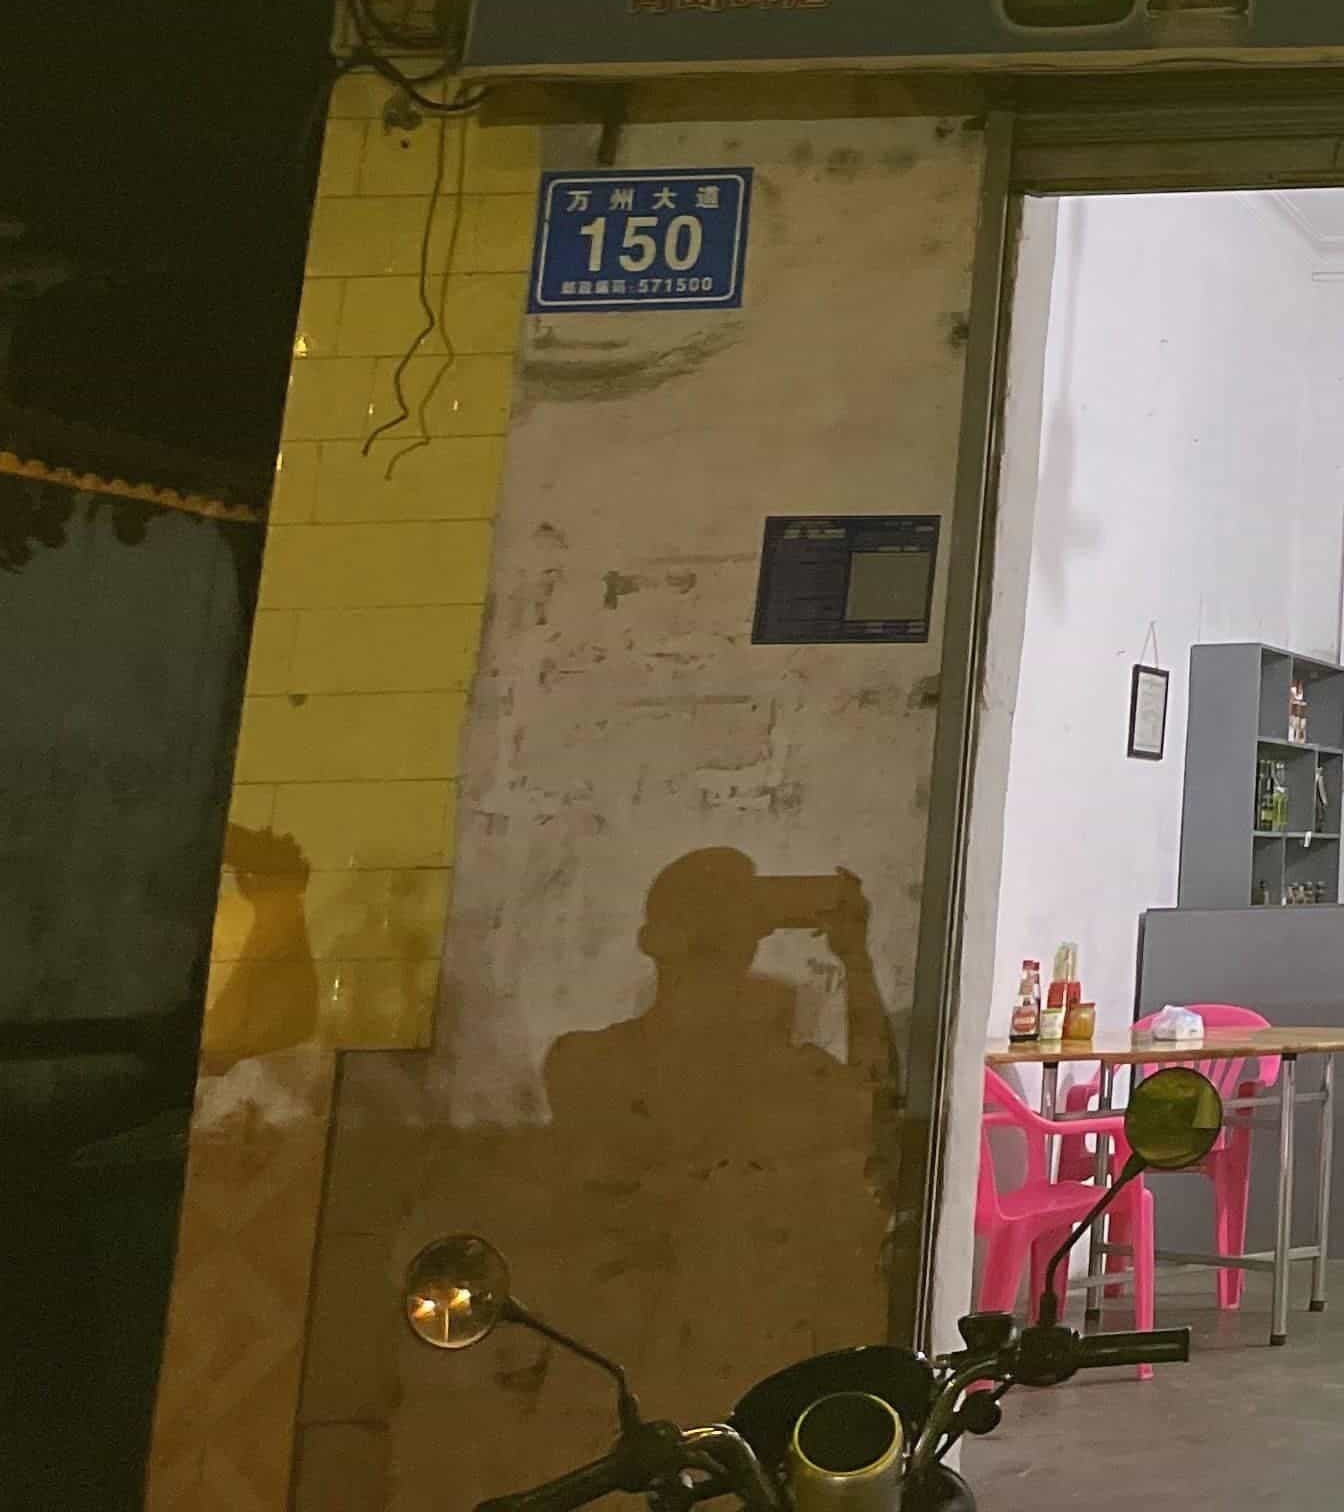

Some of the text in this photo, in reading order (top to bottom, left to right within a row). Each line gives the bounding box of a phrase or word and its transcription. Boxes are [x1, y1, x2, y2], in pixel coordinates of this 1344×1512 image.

[566, 185, 720, 213] 万州大道
[579, 215, 703, 272] 150
